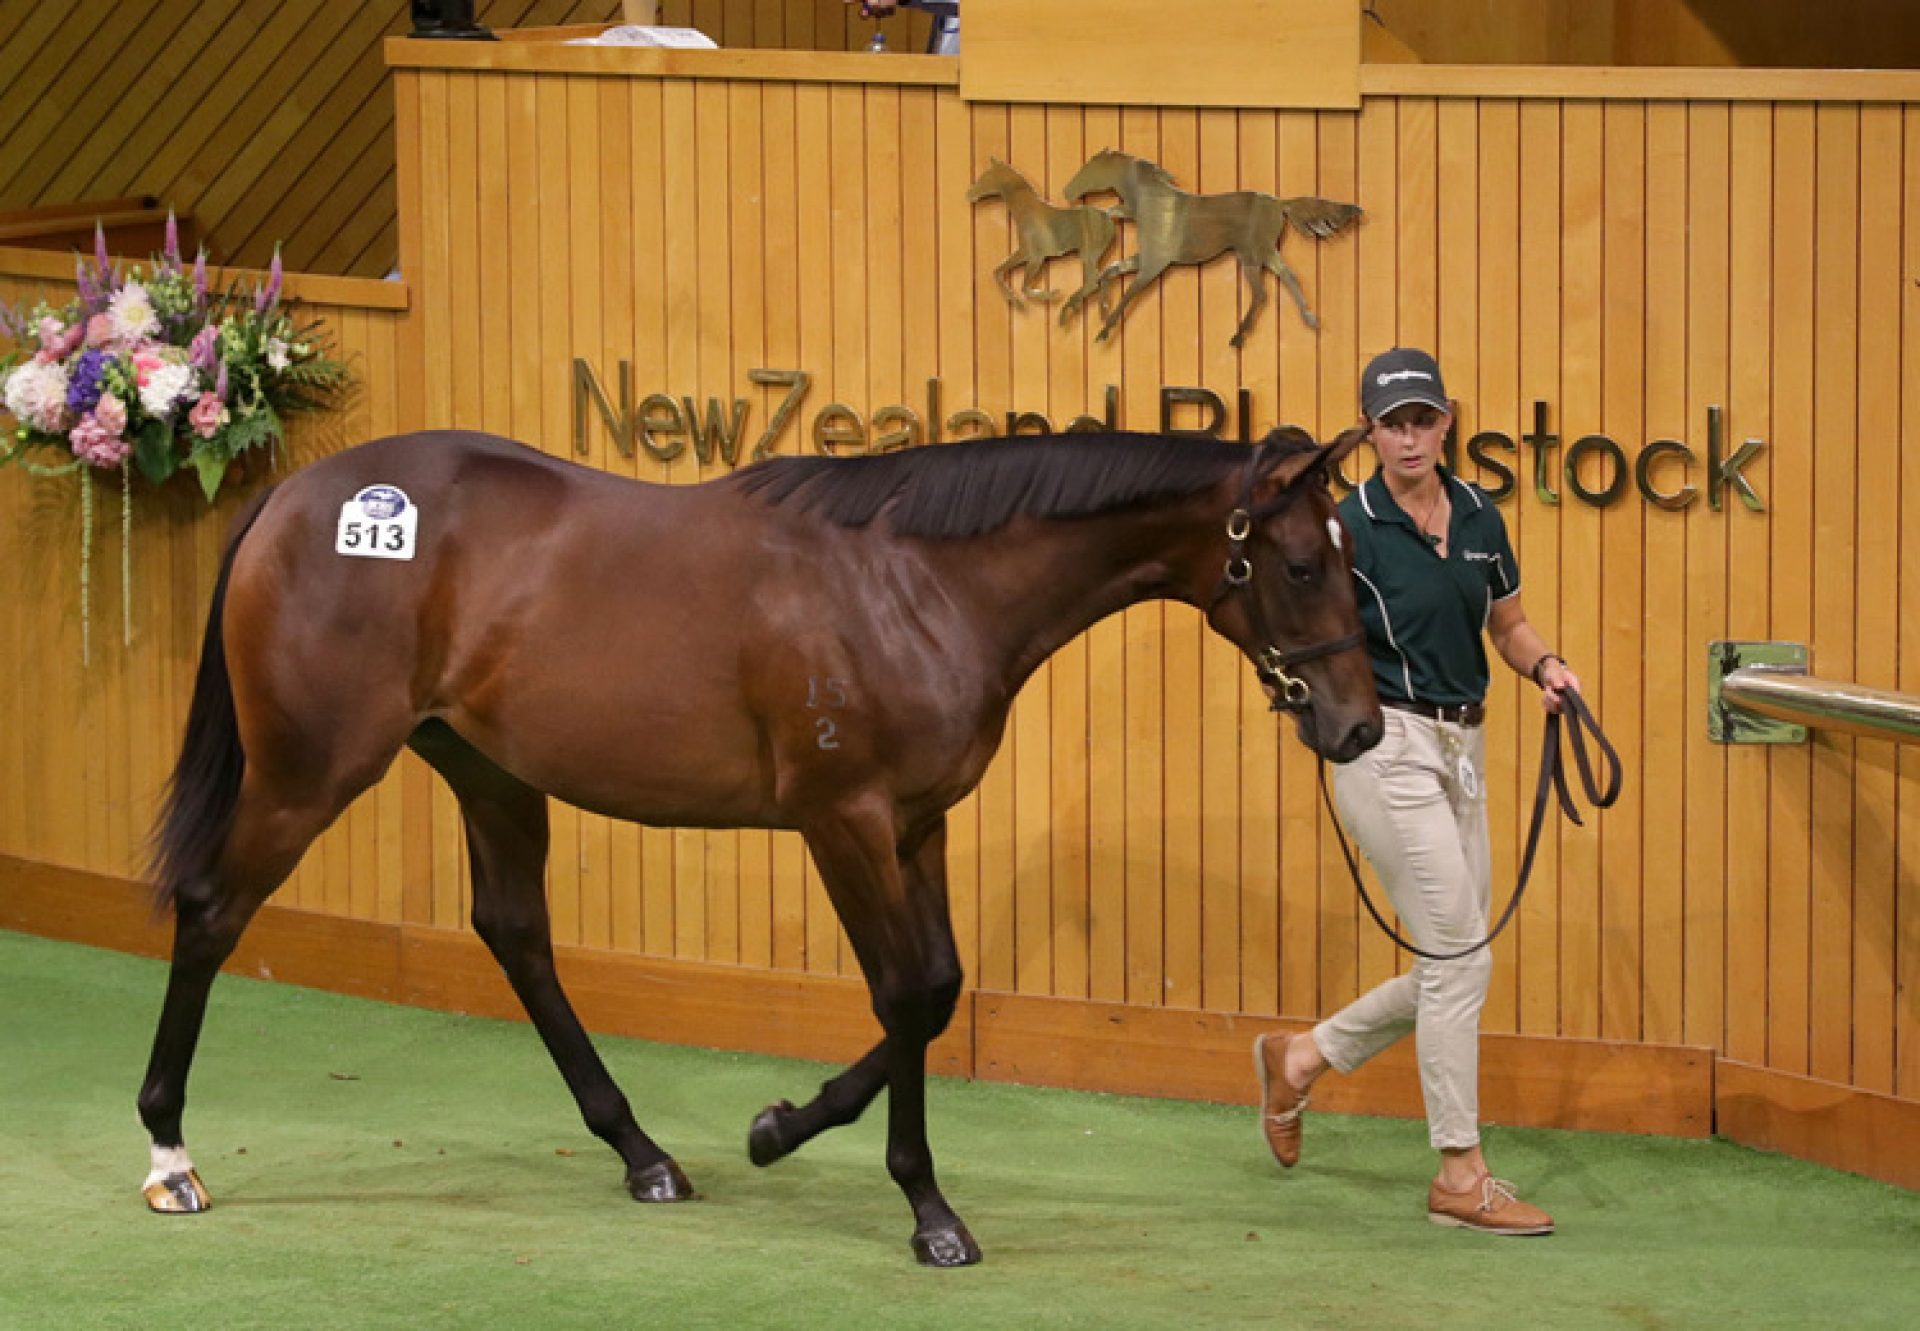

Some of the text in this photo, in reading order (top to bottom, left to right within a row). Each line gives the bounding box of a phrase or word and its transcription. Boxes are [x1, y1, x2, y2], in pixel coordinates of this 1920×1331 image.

[1160, 386, 1767, 512] Blstock
[344, 521, 405, 551] 513
[815, 716, 840, 750] 2
